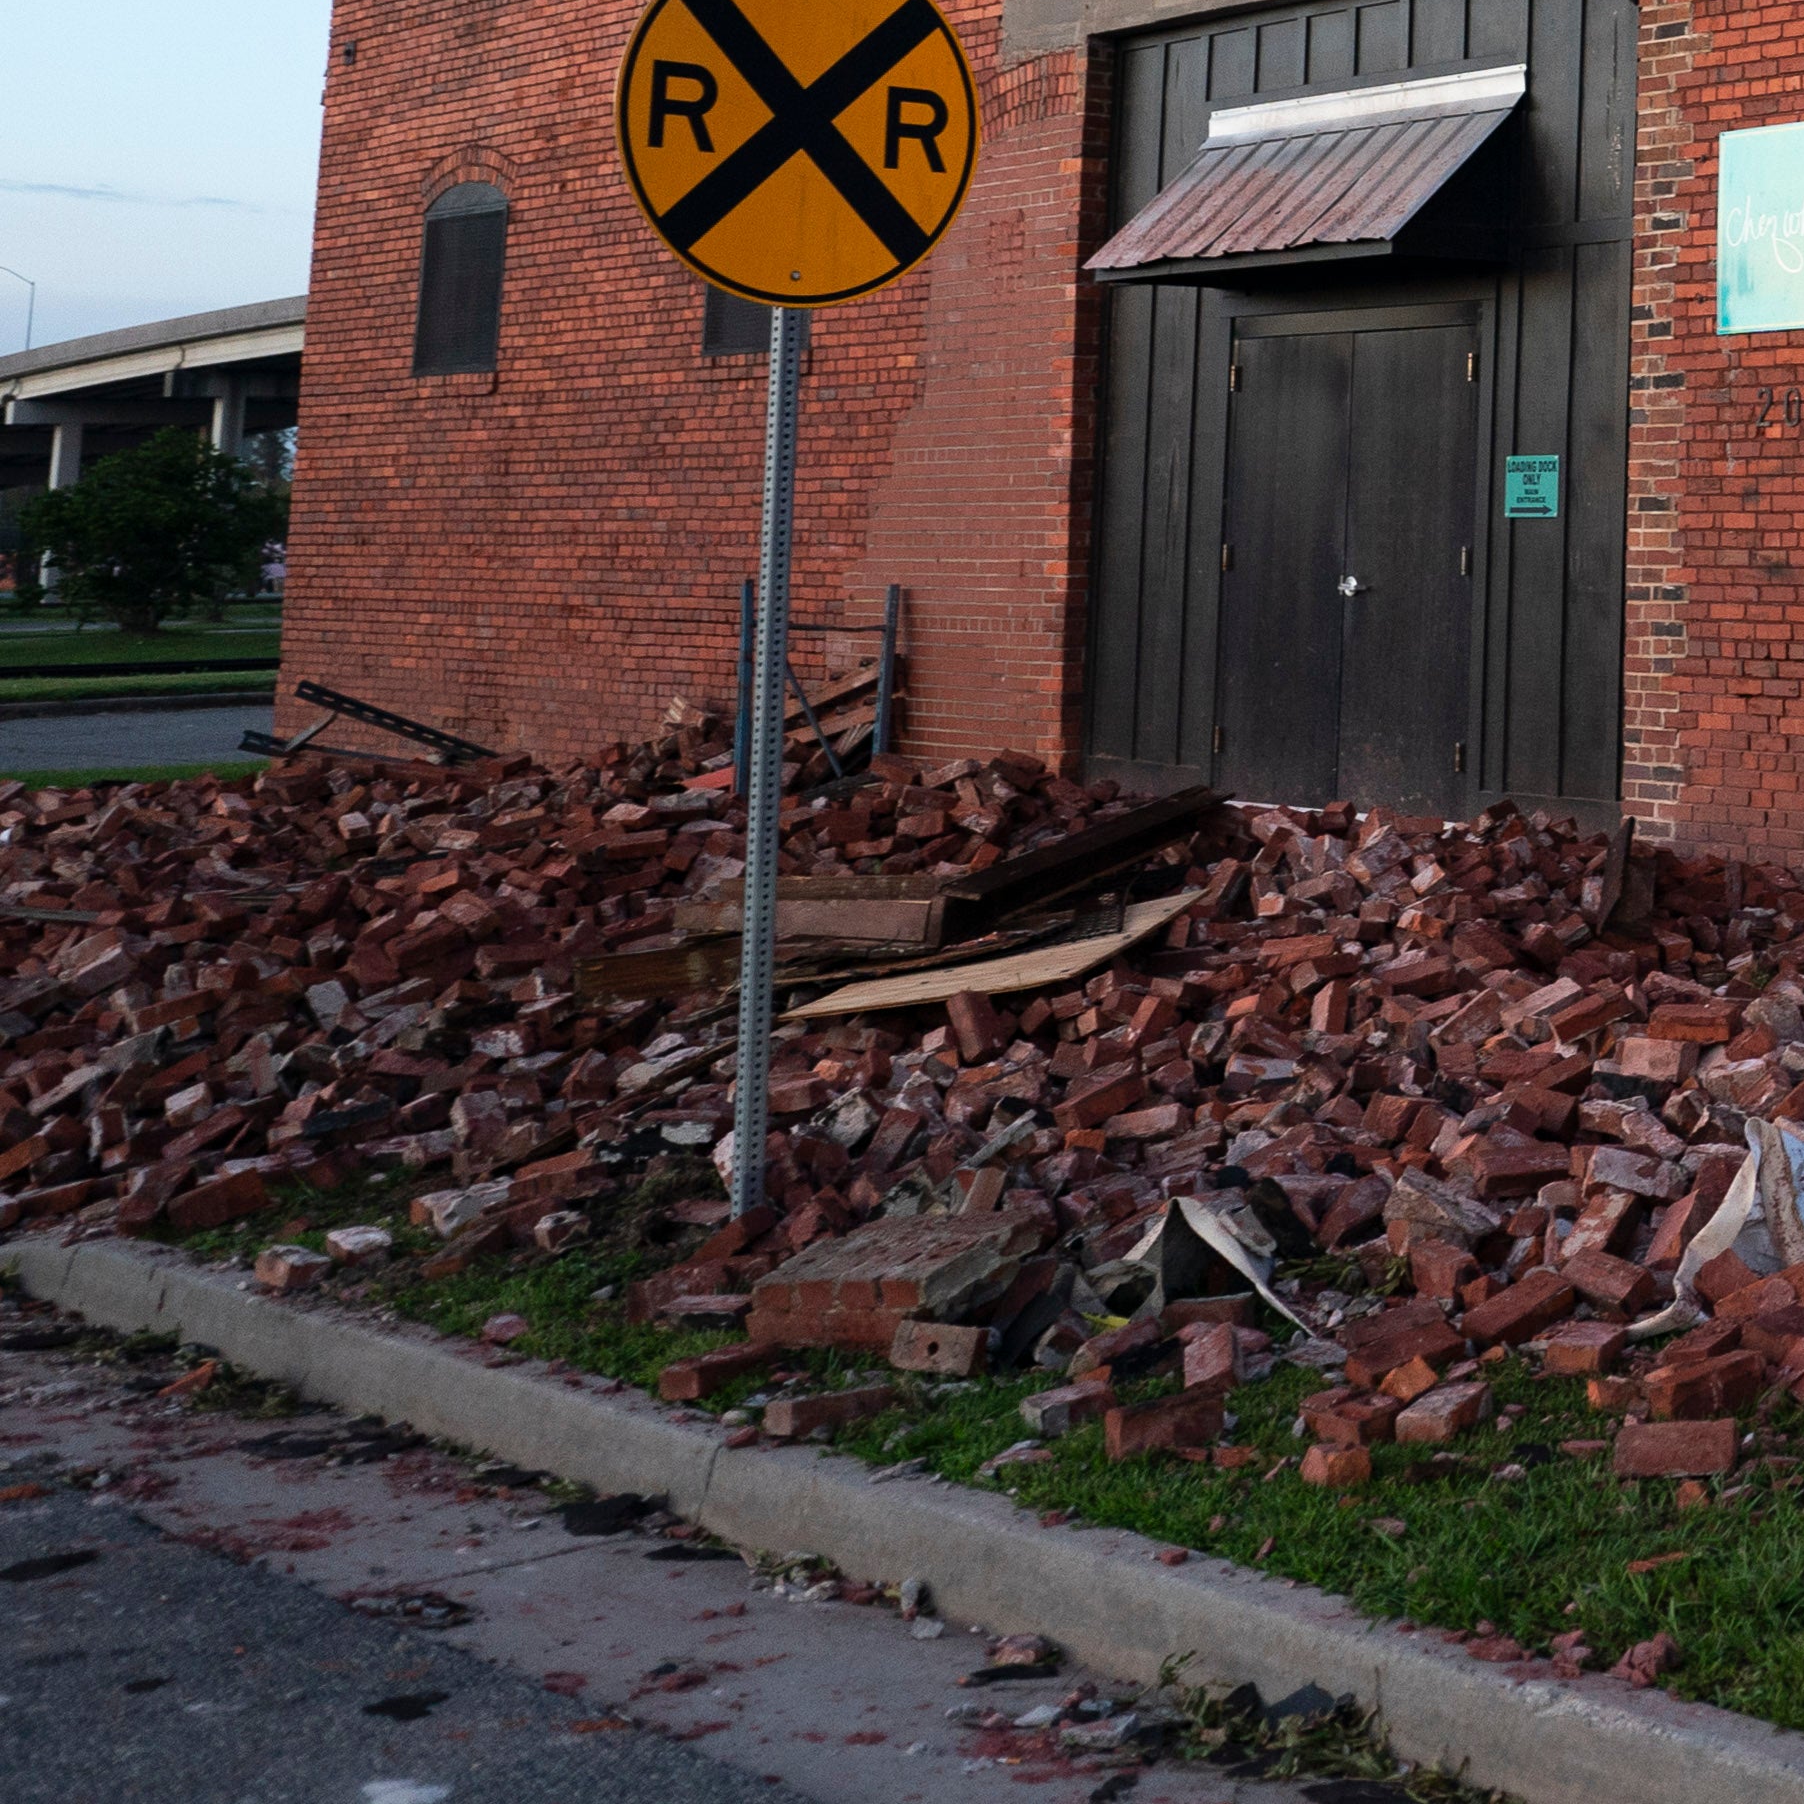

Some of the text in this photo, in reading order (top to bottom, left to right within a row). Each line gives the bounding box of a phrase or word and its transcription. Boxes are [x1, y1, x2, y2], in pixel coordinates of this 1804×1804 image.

[647, 59, 949, 173] R R
[1507, 460, 1558, 473] LOADING DOCK
[1522, 473, 1541, 485] ONLY
